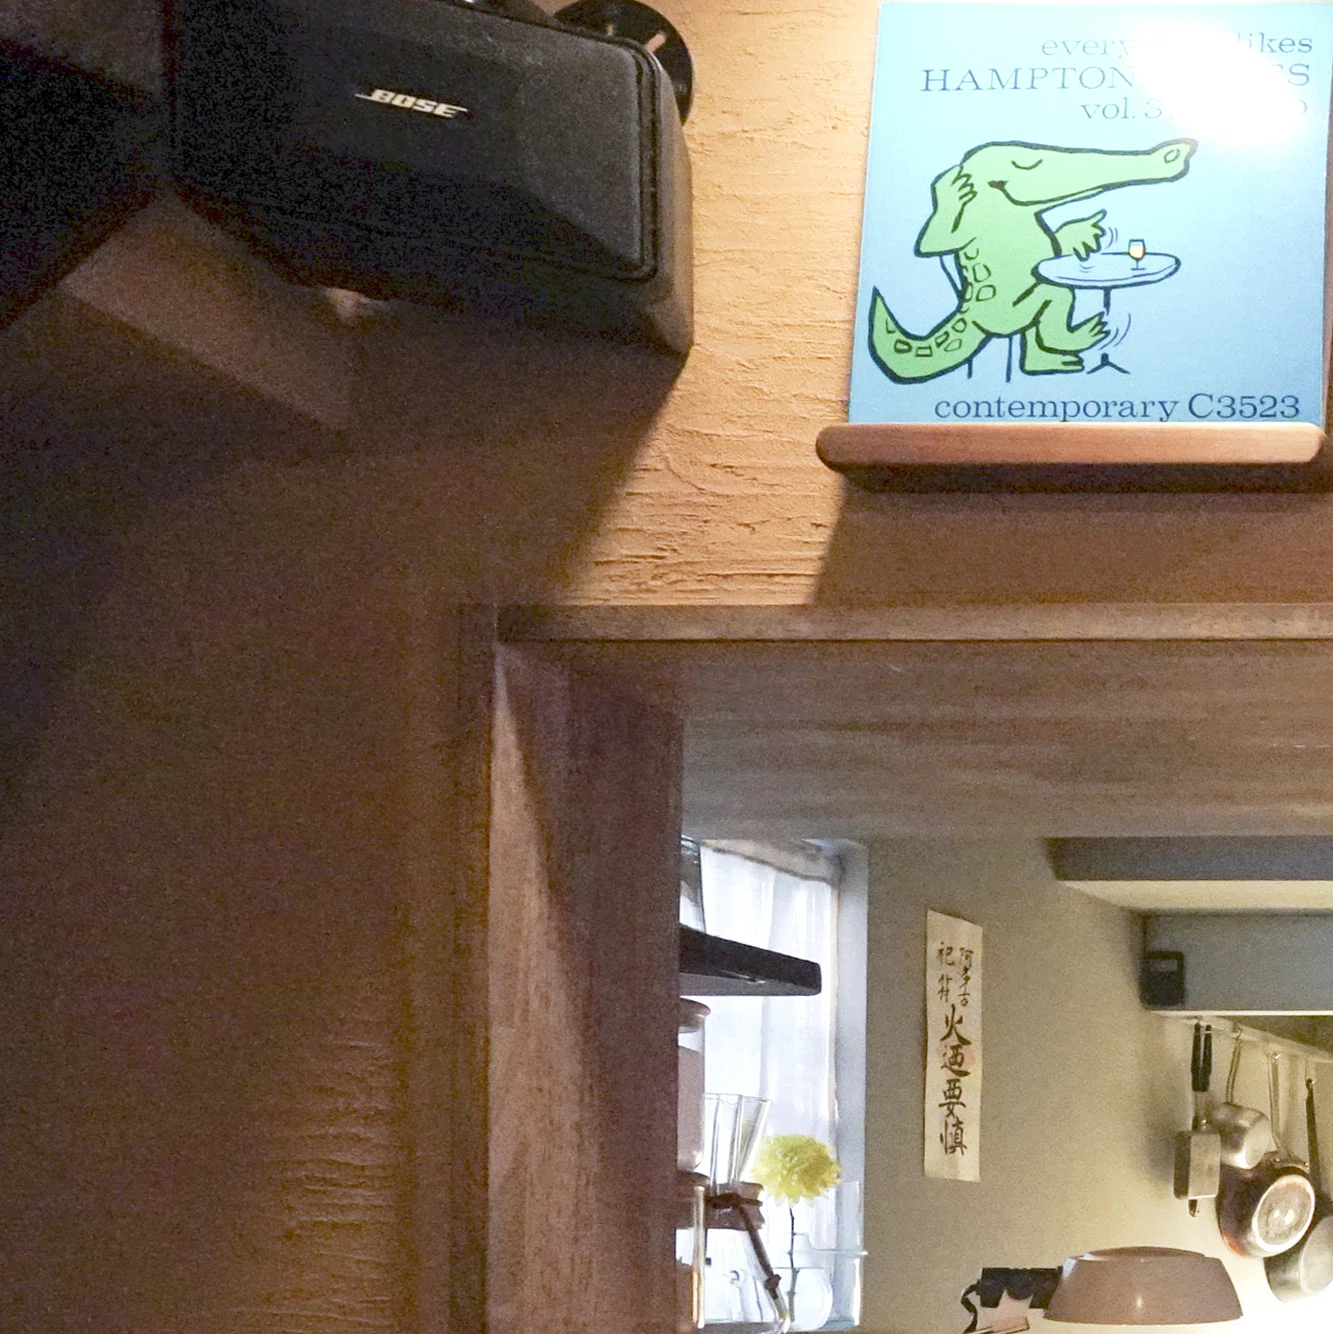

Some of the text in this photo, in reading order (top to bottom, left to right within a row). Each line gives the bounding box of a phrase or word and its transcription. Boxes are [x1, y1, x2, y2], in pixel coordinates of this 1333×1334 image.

[920, 65, 1135, 92] HAMPTON
[354, 88, 468, 118] BOSE
[1080, 97, 1136, 119] vol.
[934, 393, 1300, 422] contemporary C3523
